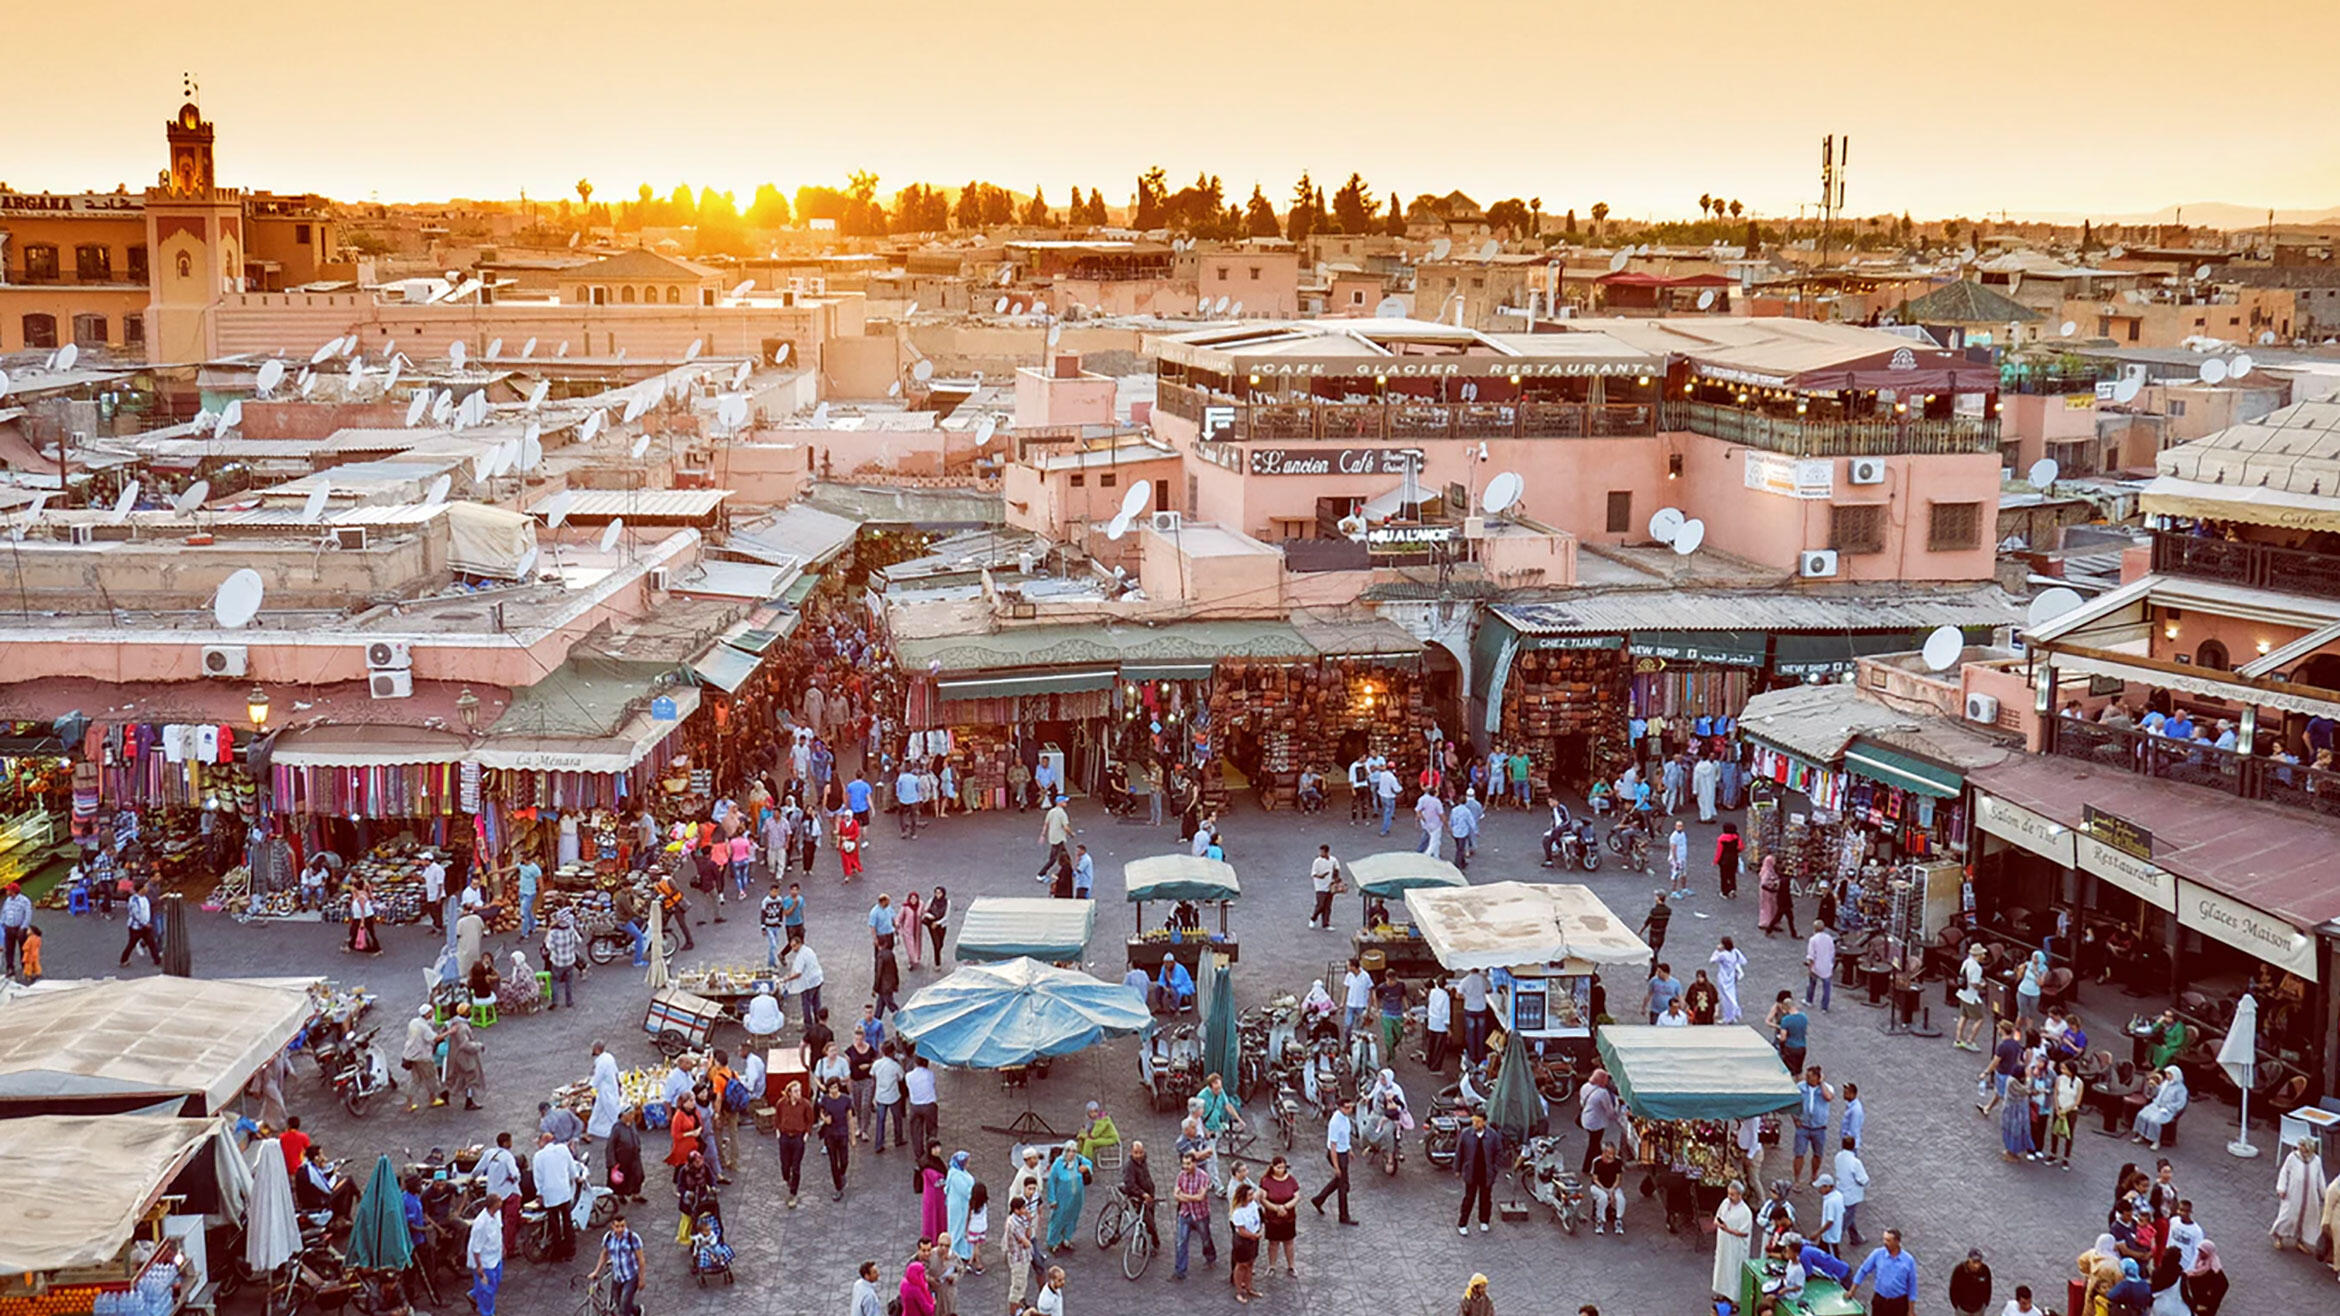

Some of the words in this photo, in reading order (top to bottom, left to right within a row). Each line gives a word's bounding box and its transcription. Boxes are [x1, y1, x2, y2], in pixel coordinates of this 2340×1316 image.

[1, 196, 73, 210] ARGANA
[1356, 364, 1460, 375] GLACIER
[1489, 364, 1643, 375] RESTAURANT
[1262, 450, 1330, 474] L'ancien
[1339, 449, 1374, 474] Café
[1539, 638, 1567, 649] CHEZ
[1570, 637, 1604, 649] TIJANI
[1628, 645, 1654, 655] NEW
[1781, 663, 1807, 674] NEW
[515, 754, 532, 766] La
[1990, 804, 2020, 829] Salon
[2021, 816, 2035, 834] de
[2093, 845, 2160, 888] Restaurant
[2198, 900, 2239, 929] Glaces
[2241, 918, 2293, 951] Maison
